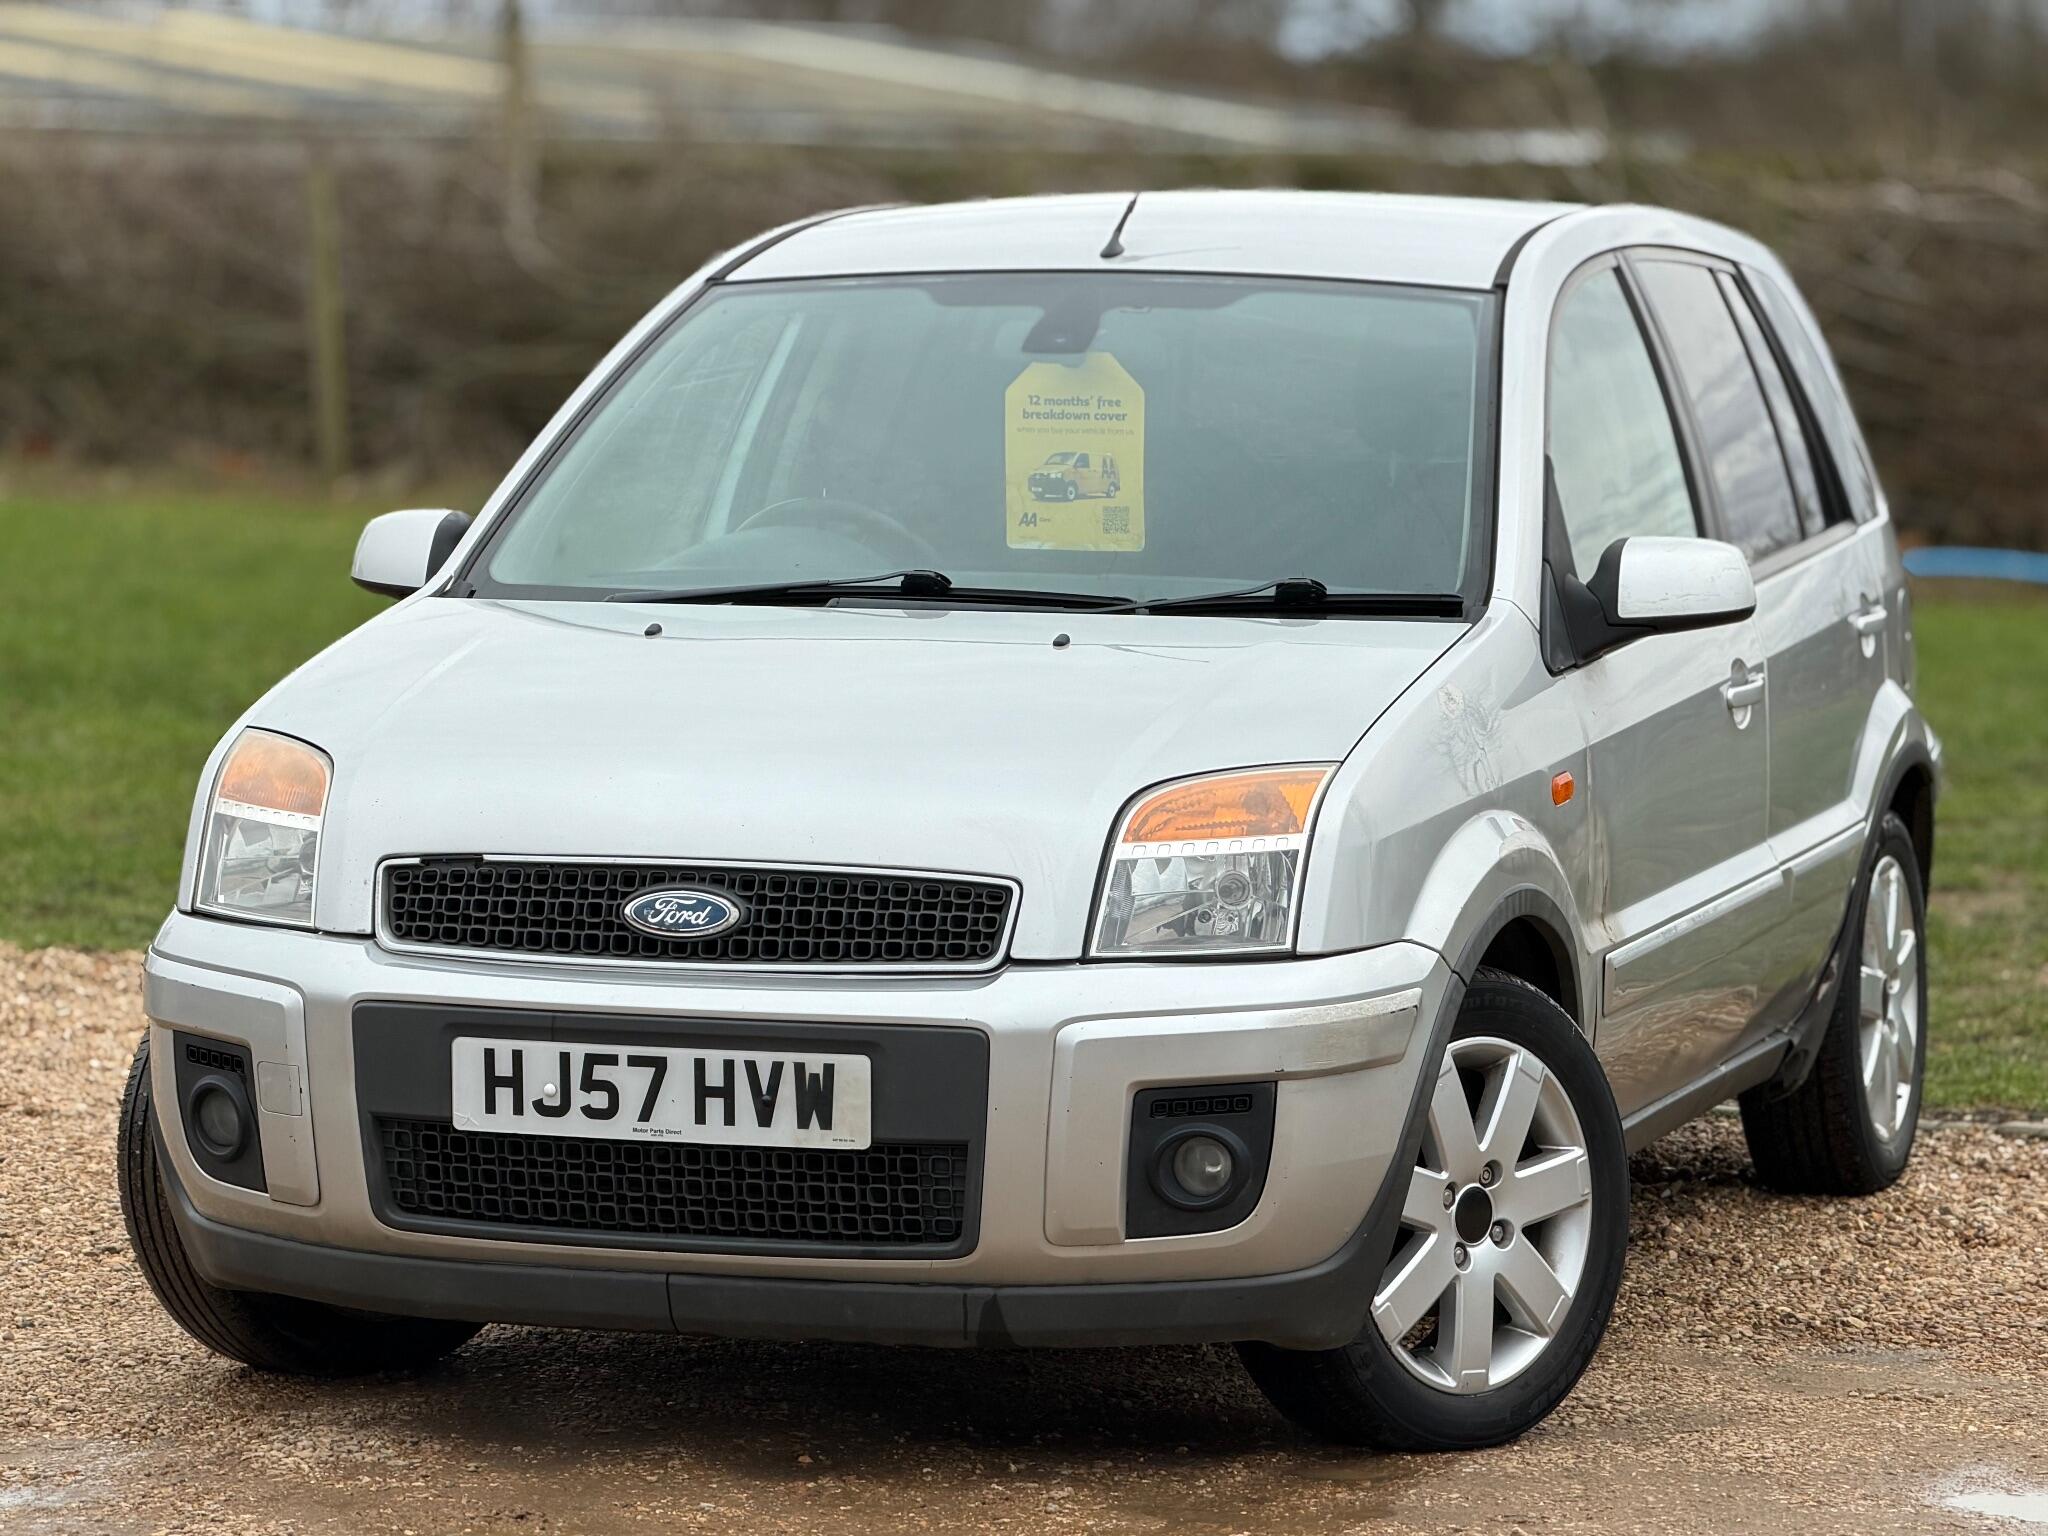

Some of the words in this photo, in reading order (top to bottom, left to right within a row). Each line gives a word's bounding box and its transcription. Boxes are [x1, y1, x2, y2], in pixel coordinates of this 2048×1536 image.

[1028, 395, 1041, 406] 12
[1044, 395, 1093, 407] months'
[1097, 396, 1122, 409] free
[1022, 408, 1090, 420] breakdown
[1094, 411, 1128, 421] cover
[1018, 511, 1038, 528] AA
[647, 897, 712, 925] Ford
[483, 1047, 669, 1123] HJ57
[693, 1057, 836, 1131] HVW
